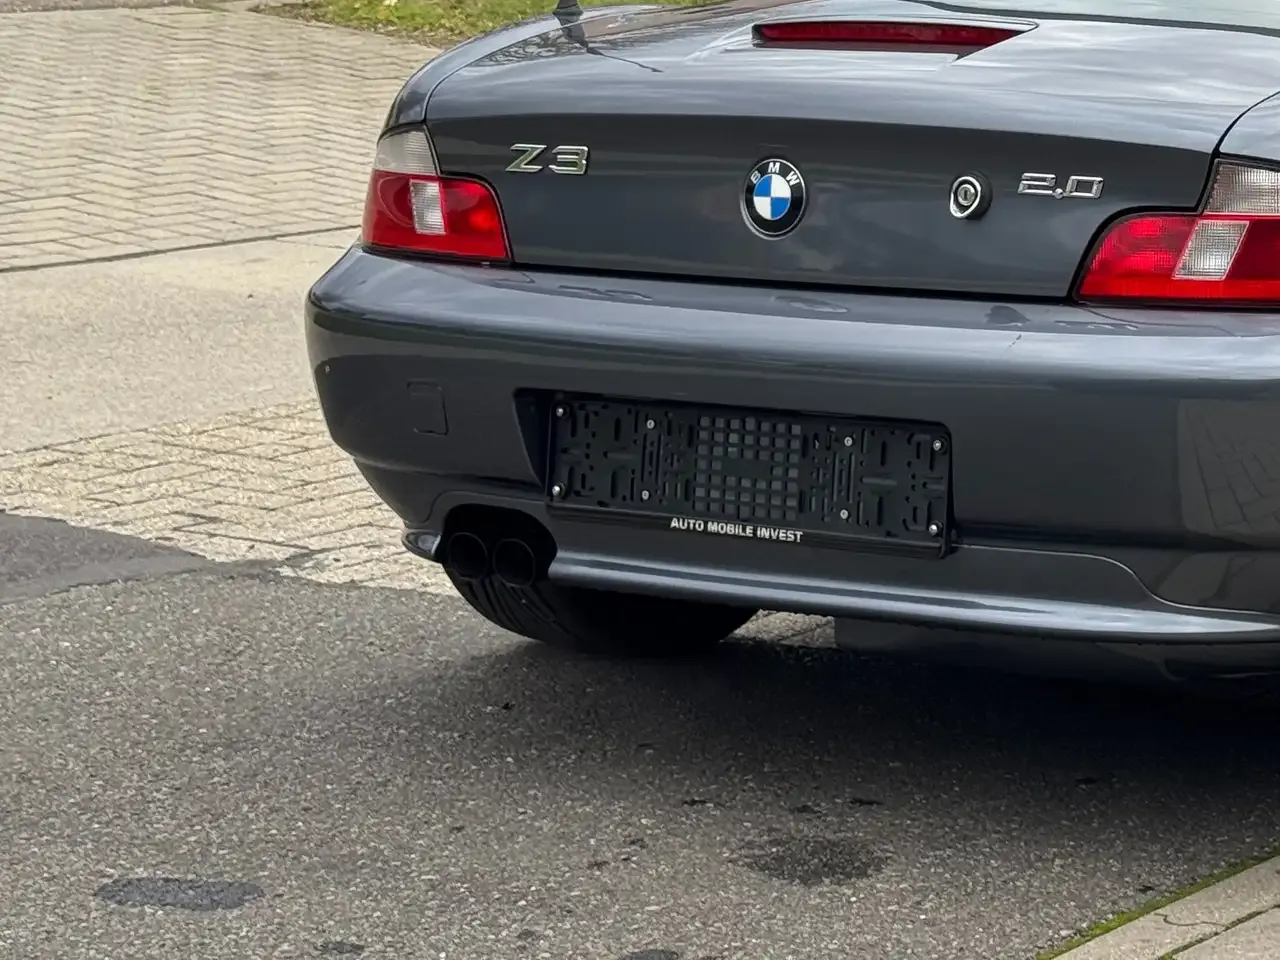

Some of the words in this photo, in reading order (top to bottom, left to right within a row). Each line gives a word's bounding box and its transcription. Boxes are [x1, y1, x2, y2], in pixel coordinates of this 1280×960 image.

[505, 143, 589, 175] Z3
[750, 161, 800, 187] BMW
[1017, 172, 1104, 200] 2.0
[670, 517, 704, 532] AUTO
[707, 521, 754, 537] MOBILE
[756, 526, 803, 543] INVEST
